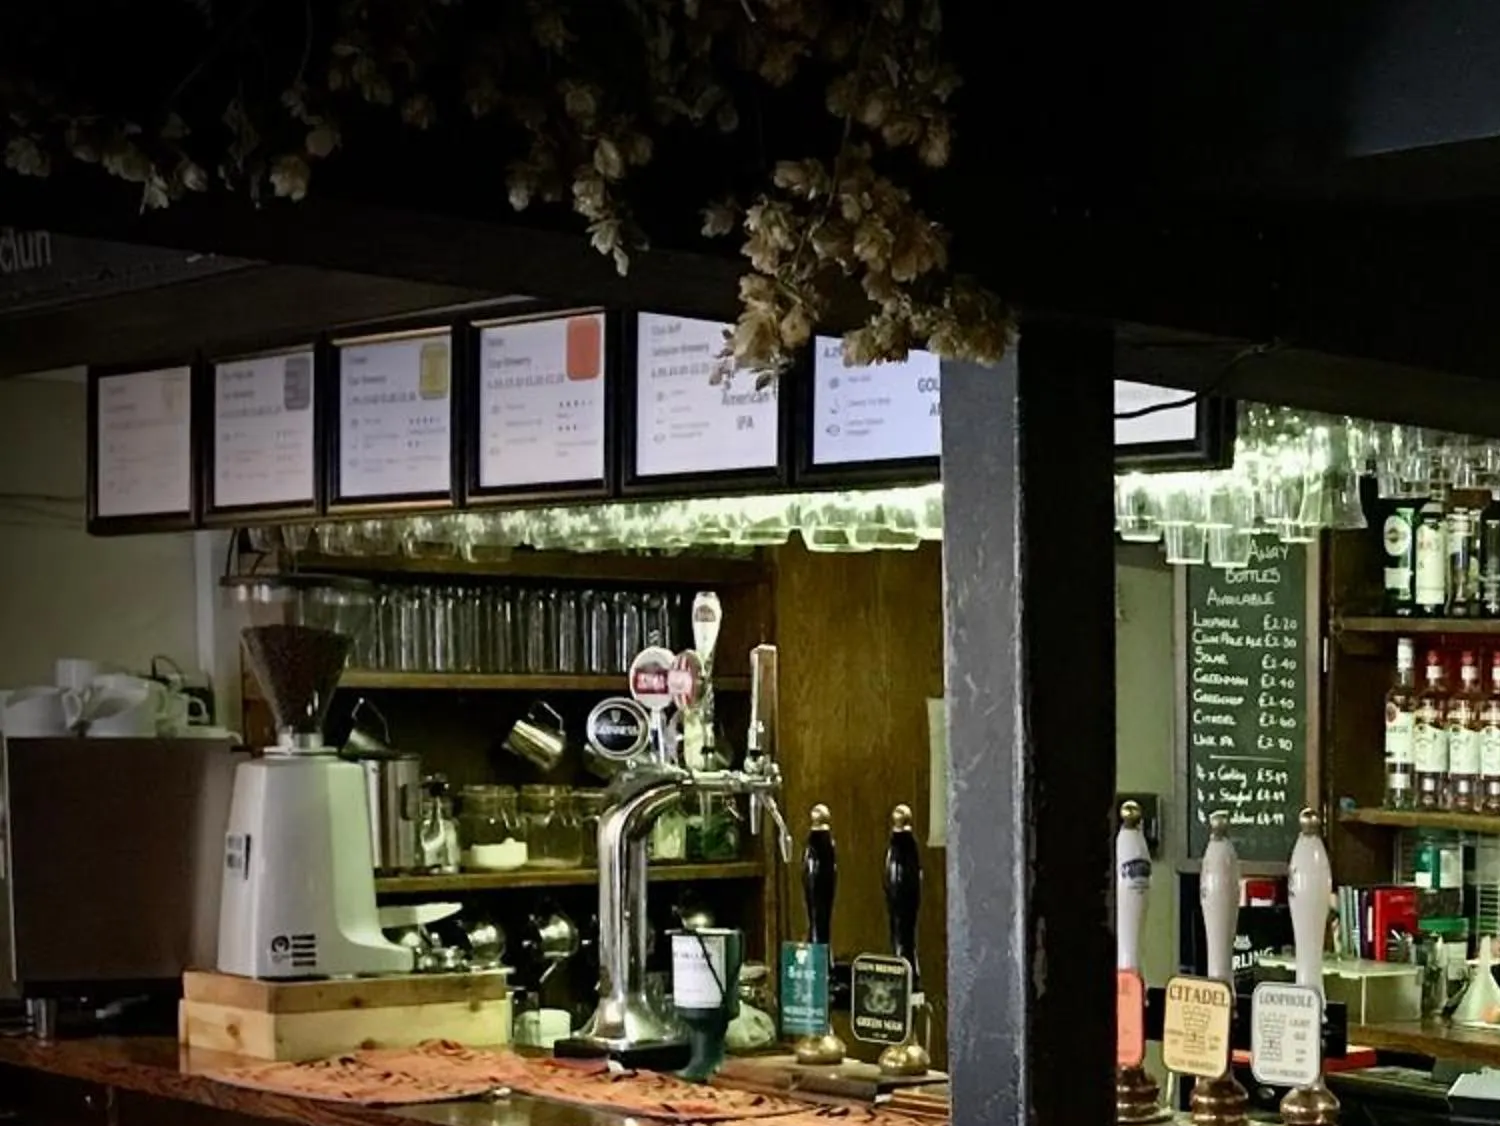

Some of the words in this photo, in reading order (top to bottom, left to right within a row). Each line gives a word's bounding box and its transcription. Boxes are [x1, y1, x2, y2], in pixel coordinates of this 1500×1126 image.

[1248, 538, 1289, 561] AWAY
[1225, 567, 1281, 584] BOTTLES
[1206, 587, 1275, 607] AVAILABLE
[1232, 946, 1274, 971] RLING
[1169, 983, 1228, 1007] CITADEL
[1259, 991, 1312, 1008] LOOPHOLE
